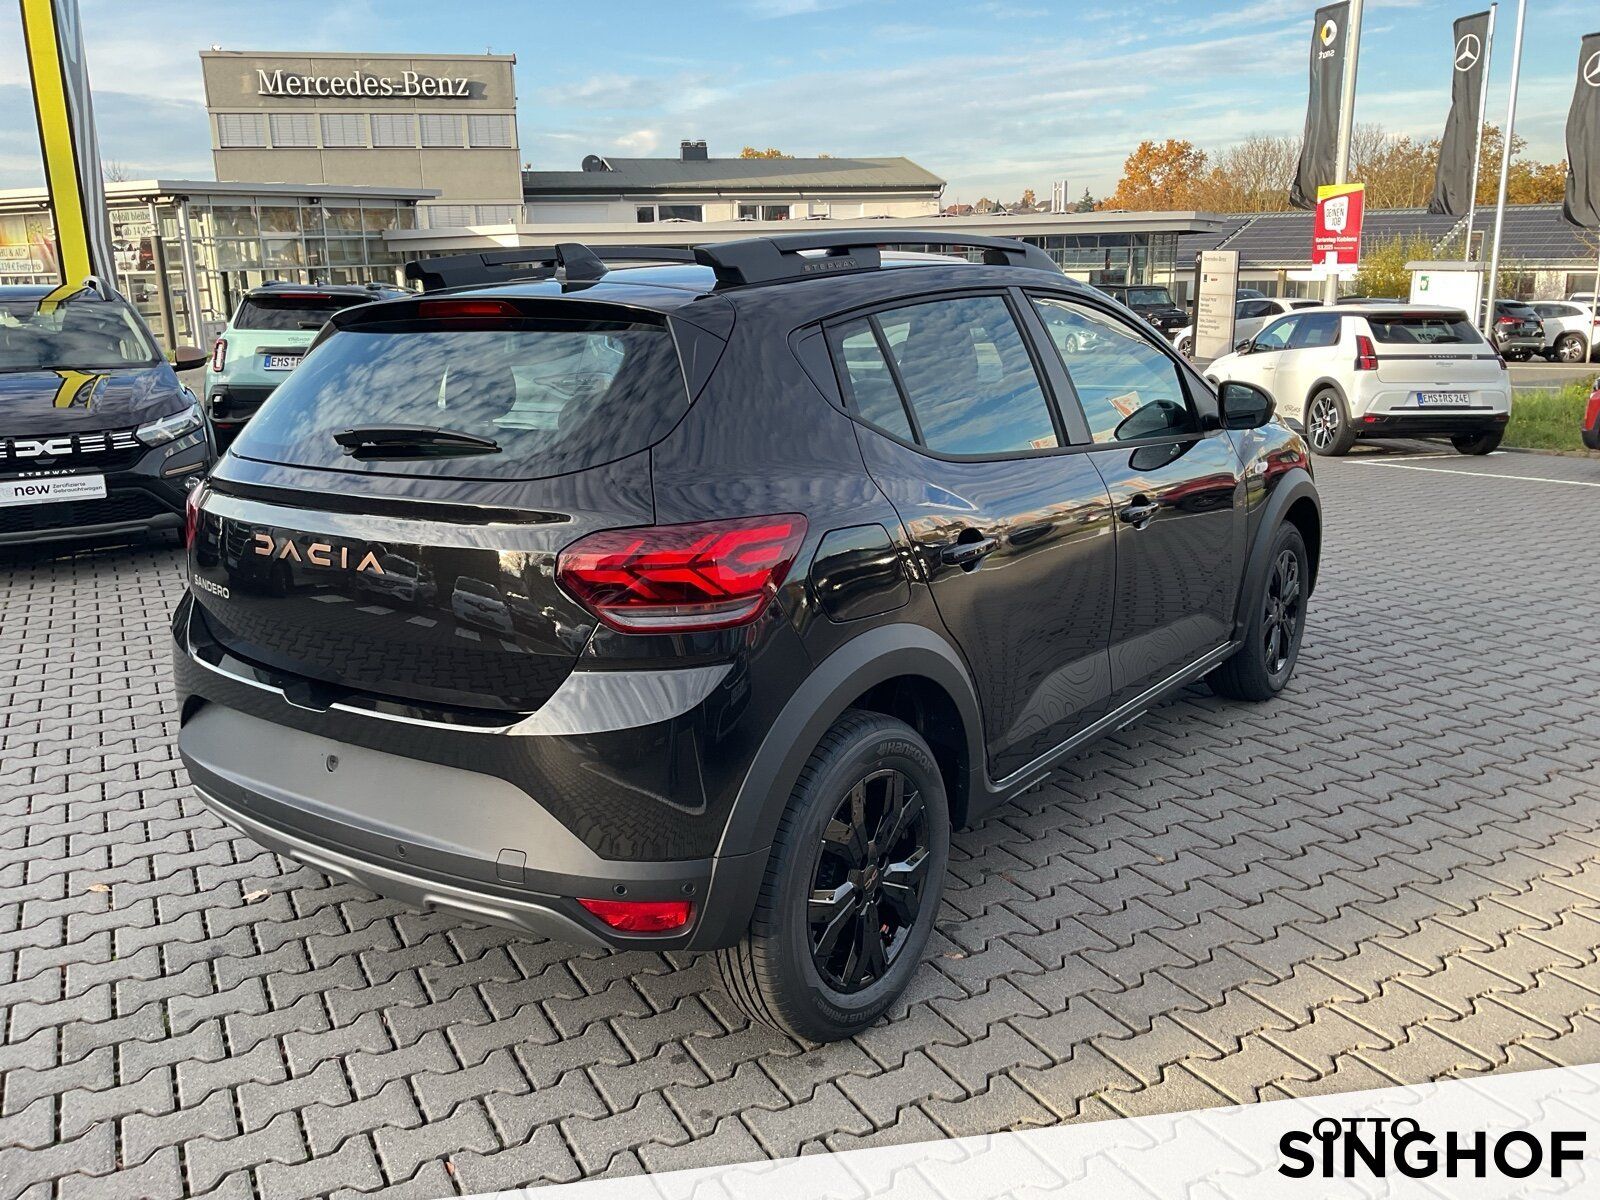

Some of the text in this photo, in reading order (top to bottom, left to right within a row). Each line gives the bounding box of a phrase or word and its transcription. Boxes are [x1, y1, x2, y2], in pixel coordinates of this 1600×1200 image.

[256, 69, 470, 97] Mercedes-Benz
[804, 261, 857, 272] STEPWAY
[271, 357, 290, 367] EMS
[1423, 394, 1469, 403] EMS RS 24E
[18, 468, 76, 477] STEPWAY
[255, 534, 386, 574] DACIA
[194, 574, 230, 599] SANDERO
